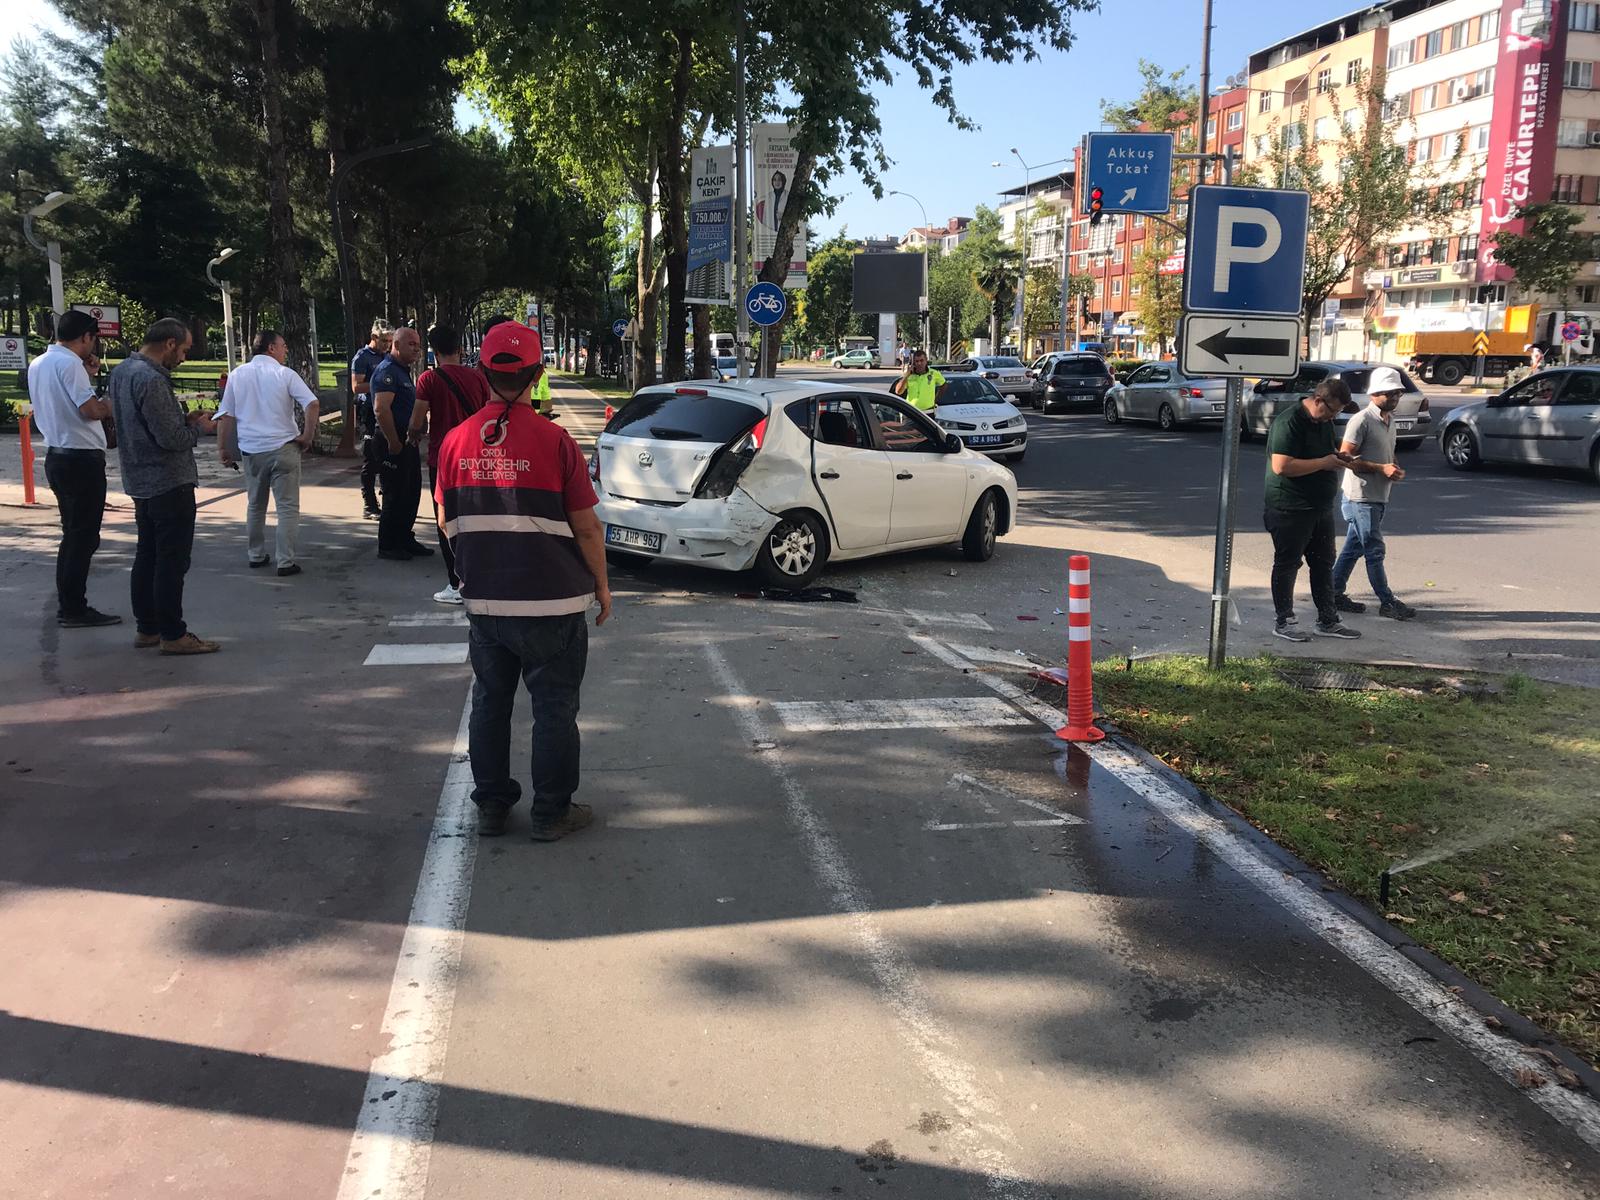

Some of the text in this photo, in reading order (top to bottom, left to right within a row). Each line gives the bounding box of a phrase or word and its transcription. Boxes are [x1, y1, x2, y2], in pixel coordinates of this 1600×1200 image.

[1107, 147, 1154, 160] Akkuş
[1107, 163, 1149, 174] Tokat
[1502, 141, 1516, 195] ÖZEL ÜNYE
[696, 176, 726, 189] ÇAKIR
[702, 188, 720, 197] KENT
[1213, 205, 1282, 293] P
[481, 448, 506, 457] ORDU
[611, 528, 658, 548] 55 AHR 962
